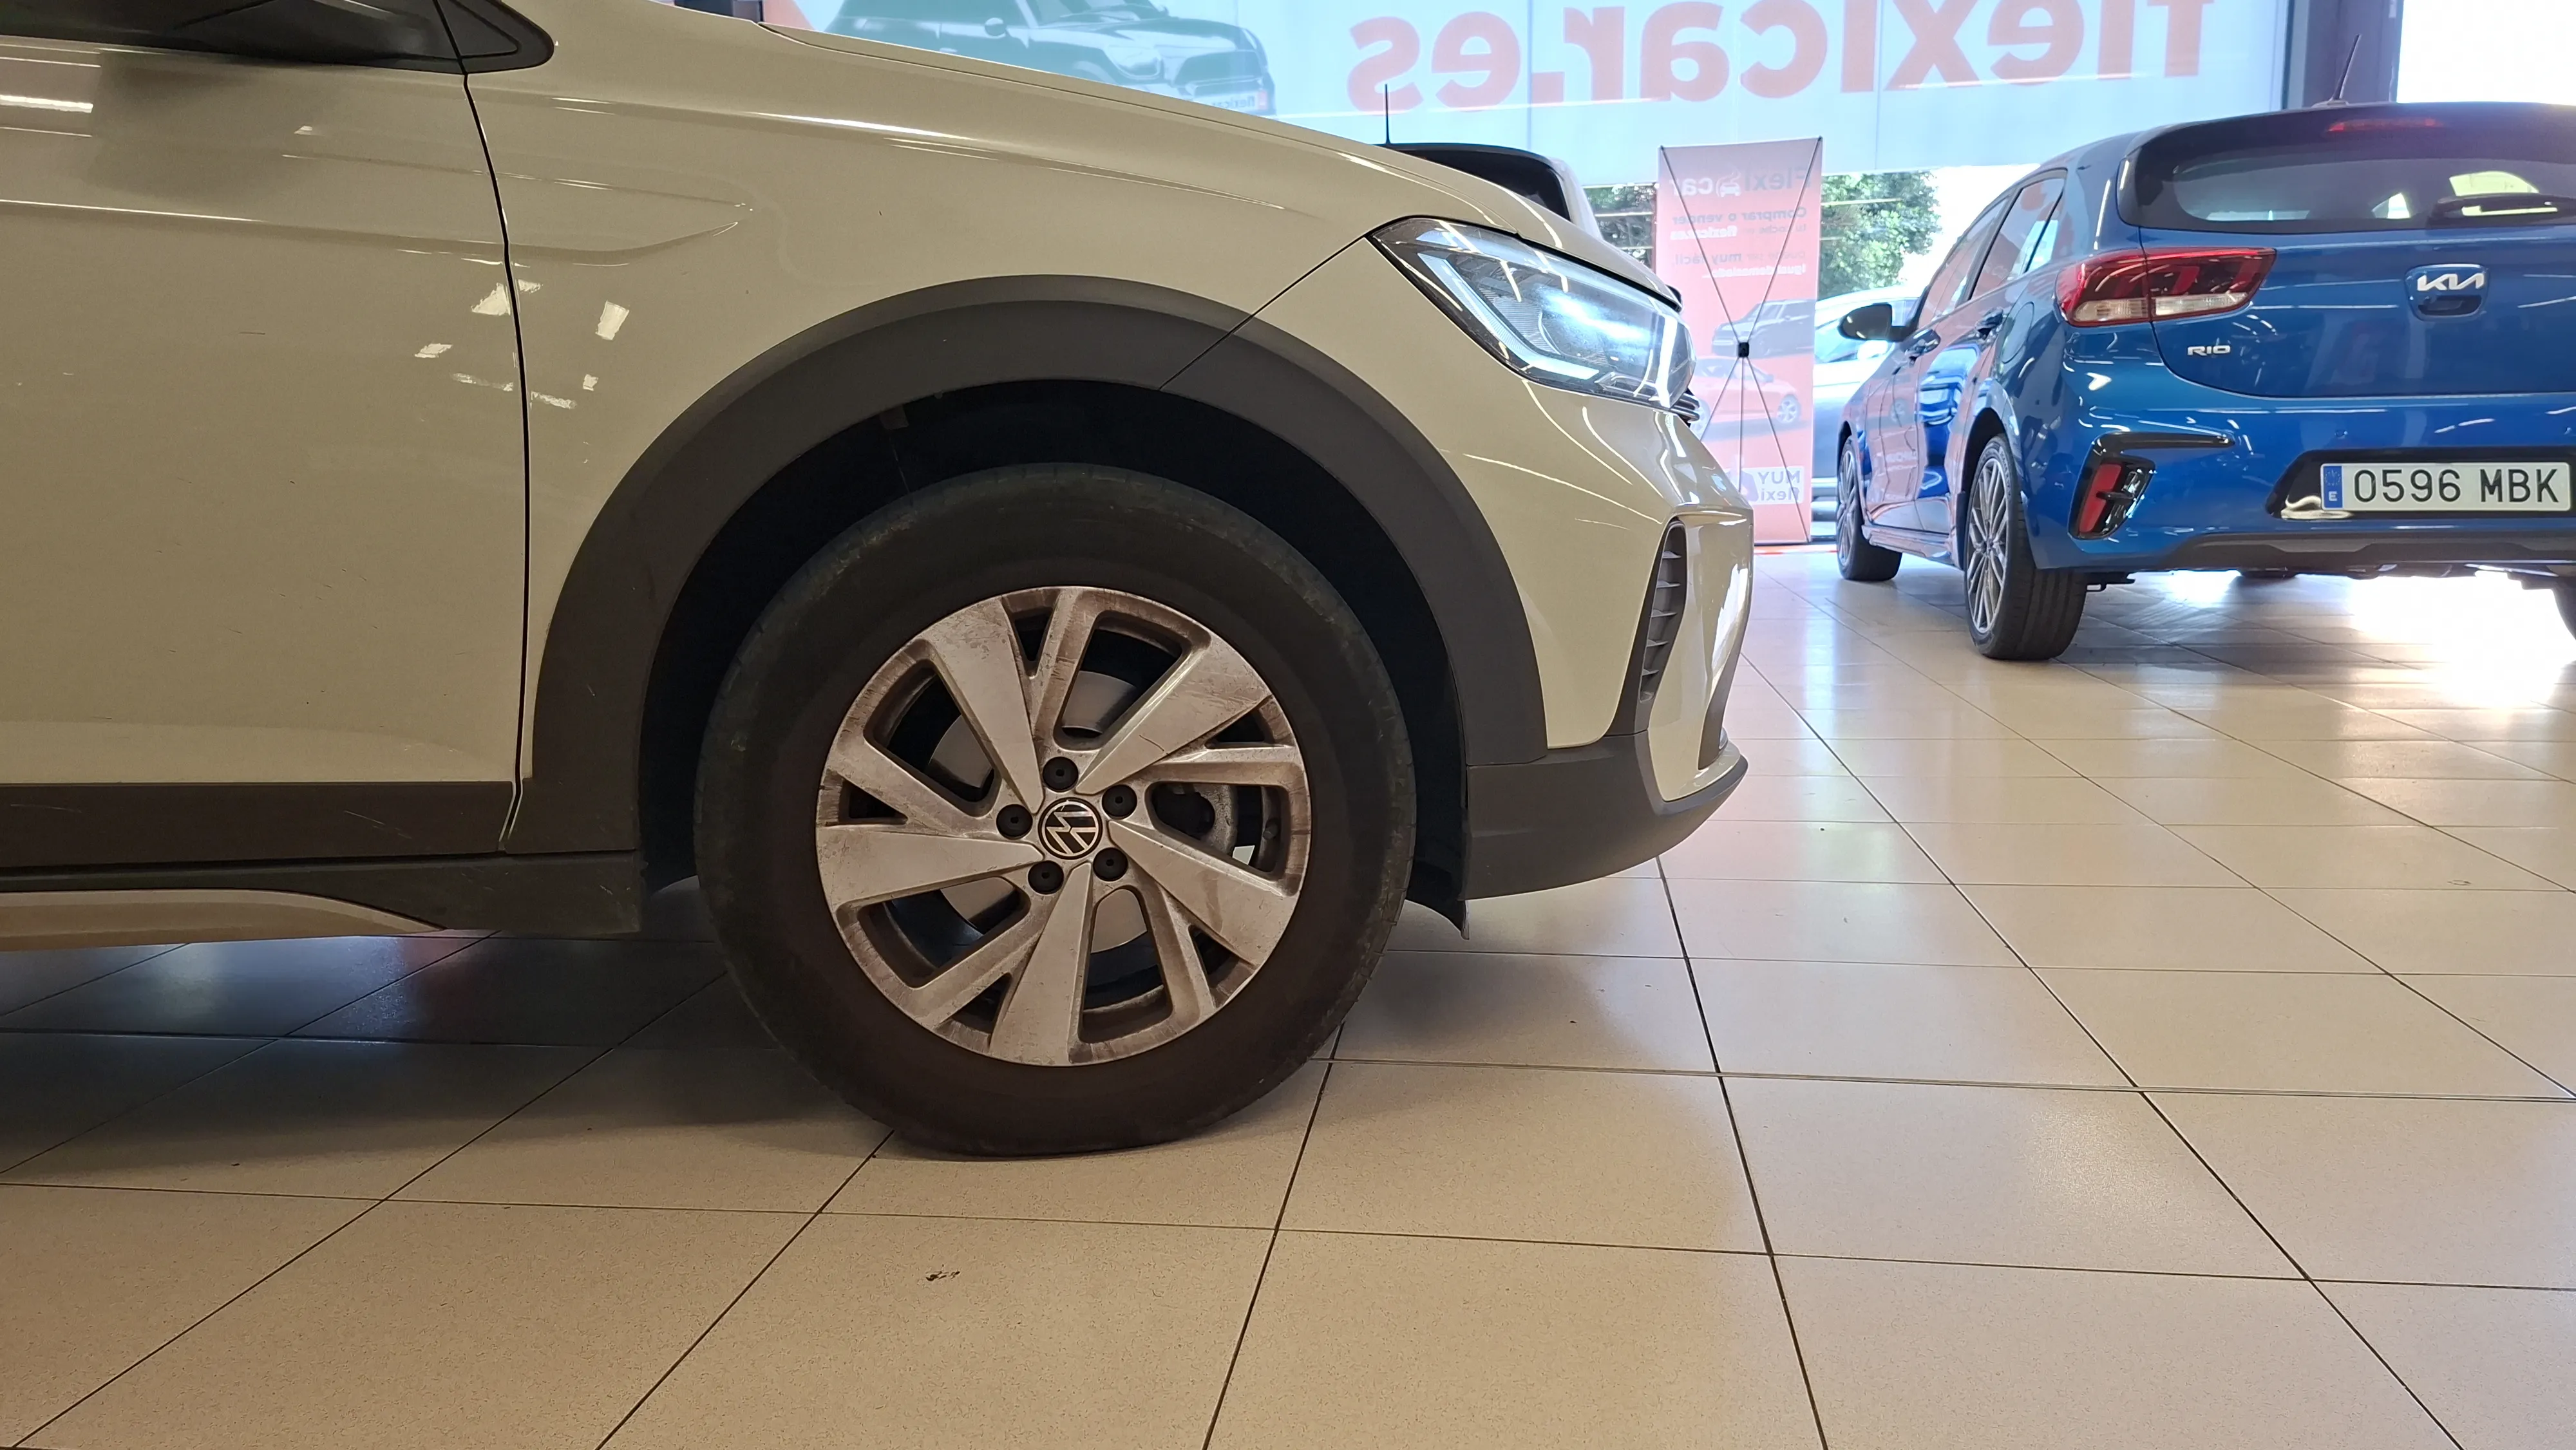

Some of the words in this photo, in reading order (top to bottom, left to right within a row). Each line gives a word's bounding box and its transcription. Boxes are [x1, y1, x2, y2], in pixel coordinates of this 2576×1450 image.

[2187, 344, 2231, 356] RIO
[2353, 469, 2461, 503] 0596
[2479, 468, 2559, 503] MBK
[2328, 491, 2338, 502] E
